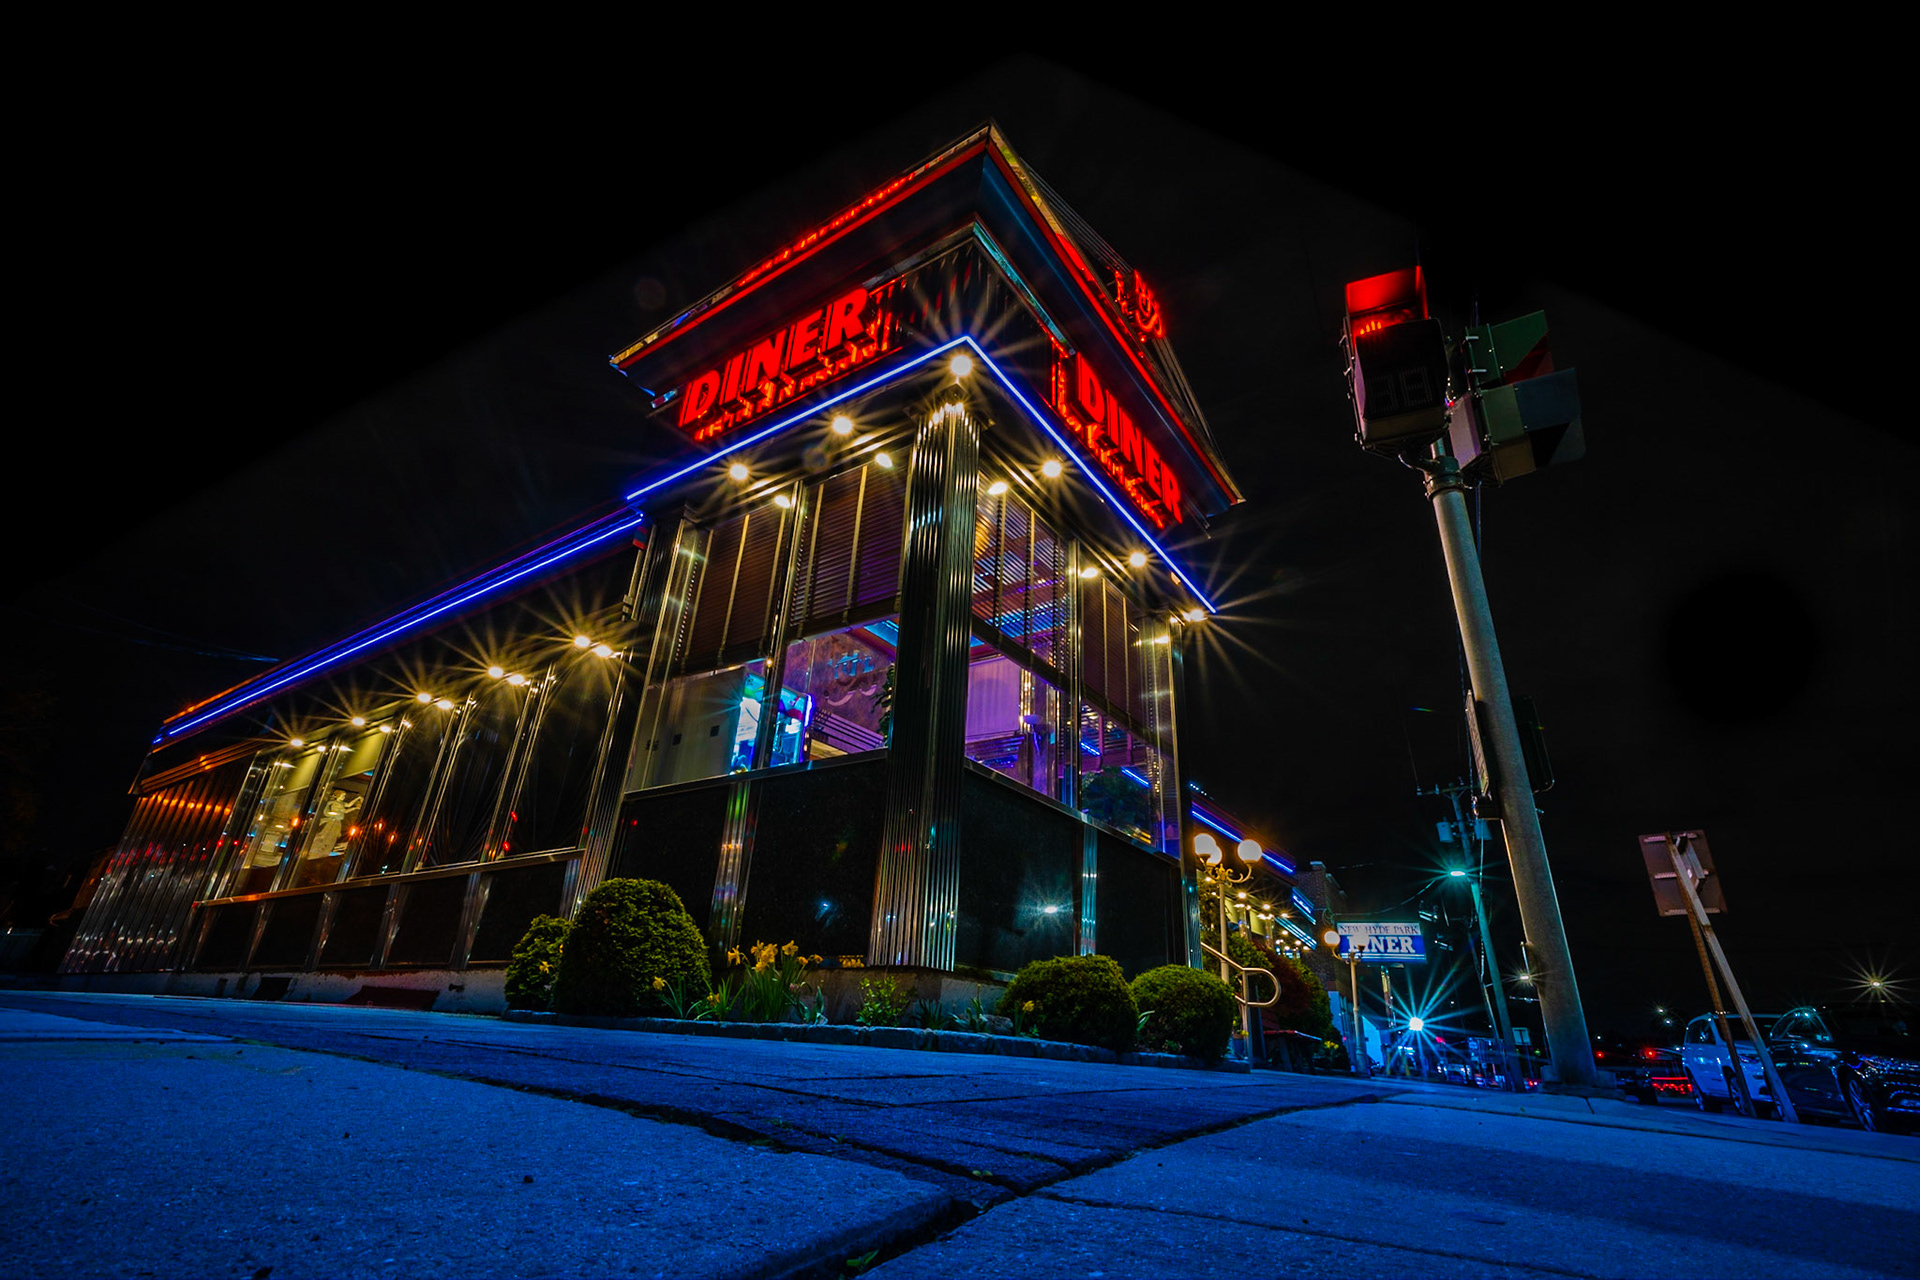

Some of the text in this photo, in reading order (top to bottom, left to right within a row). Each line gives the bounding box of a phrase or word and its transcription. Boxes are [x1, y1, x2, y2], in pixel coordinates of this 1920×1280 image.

[678, 287, 869, 427] DINER
[1076, 352, 1183, 524] DINER
[1340, 925, 1419, 934] NEW HYDE PARK
